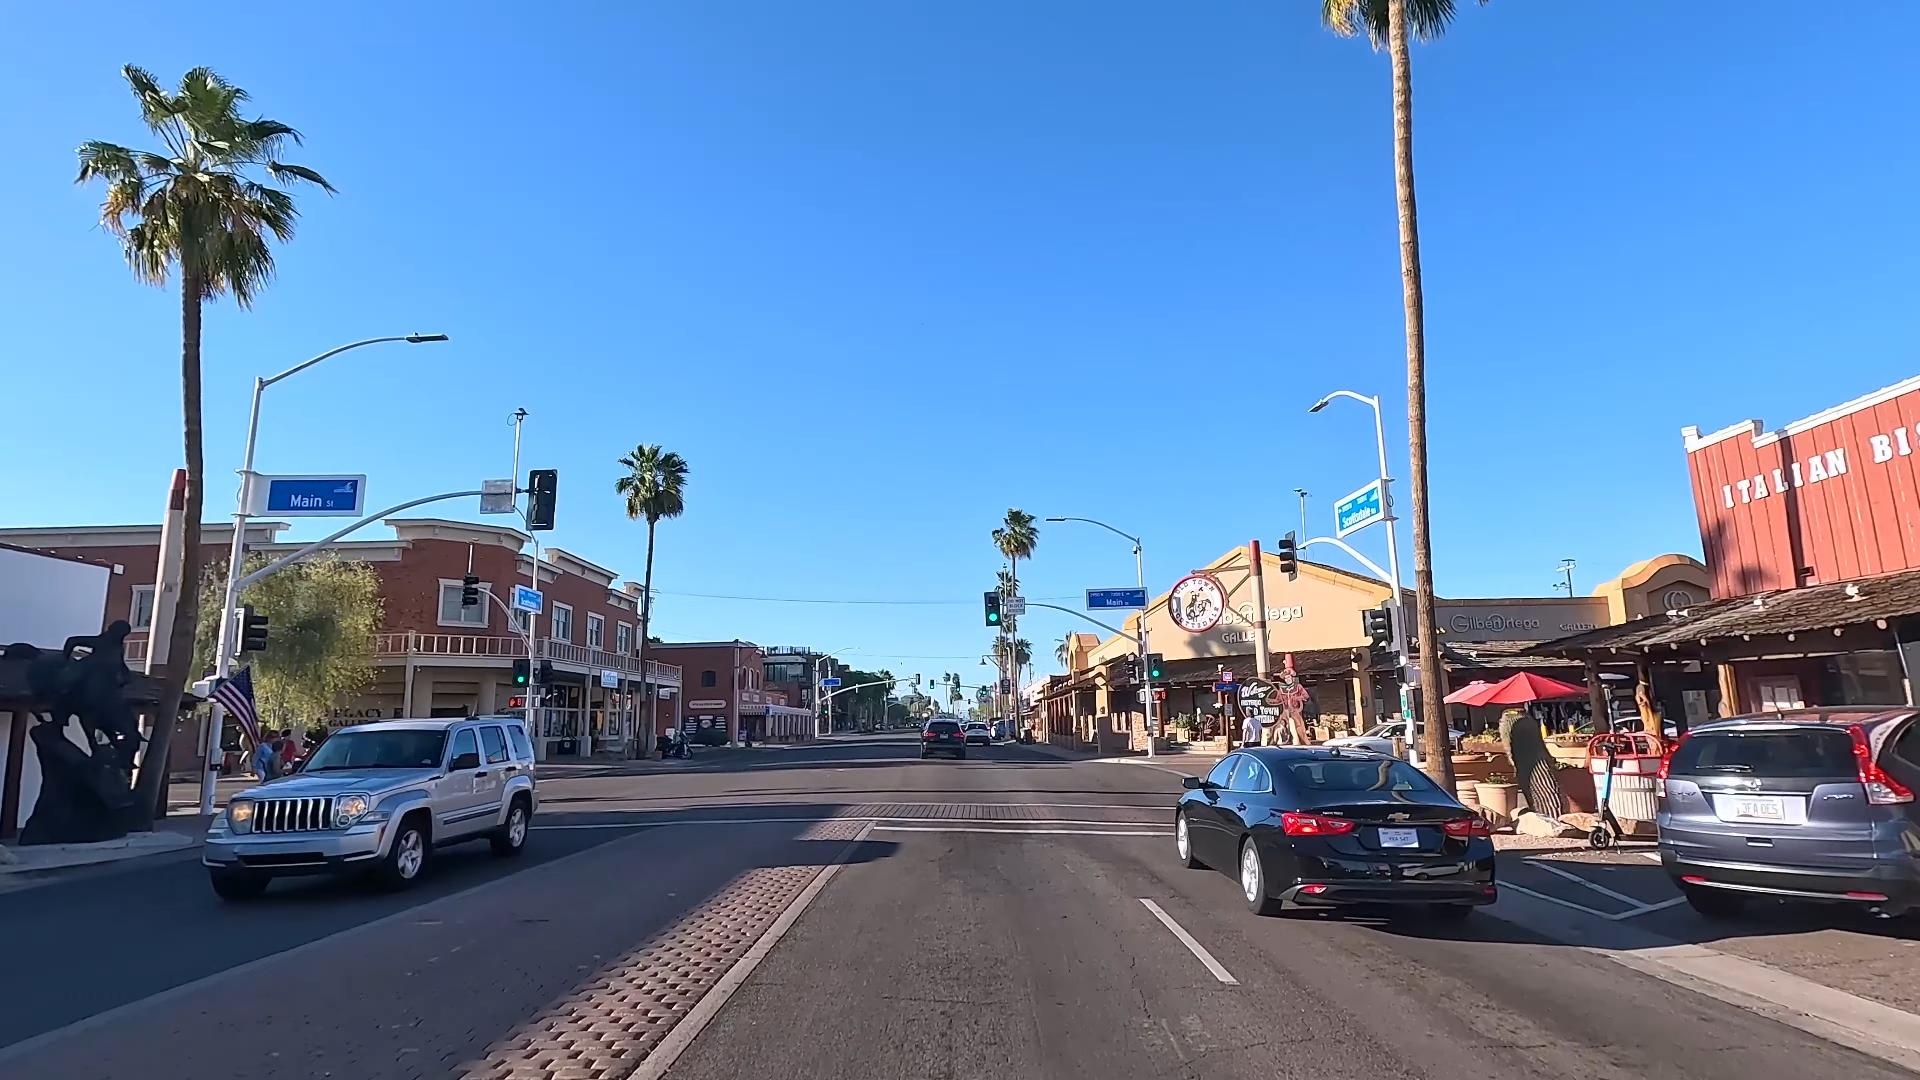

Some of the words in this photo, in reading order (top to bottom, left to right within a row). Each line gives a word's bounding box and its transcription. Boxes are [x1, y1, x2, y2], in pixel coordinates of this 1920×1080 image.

[1722, 447, 1848, 508] ITALIAN
[290, 494, 322, 508] Main
[1192, 579, 1215, 592] TOWN
[1450, 613, 1503, 633] Gilbert
[1559, 622, 1599, 631] GALLERY
[1260, 706, 1280, 716] TOWN
